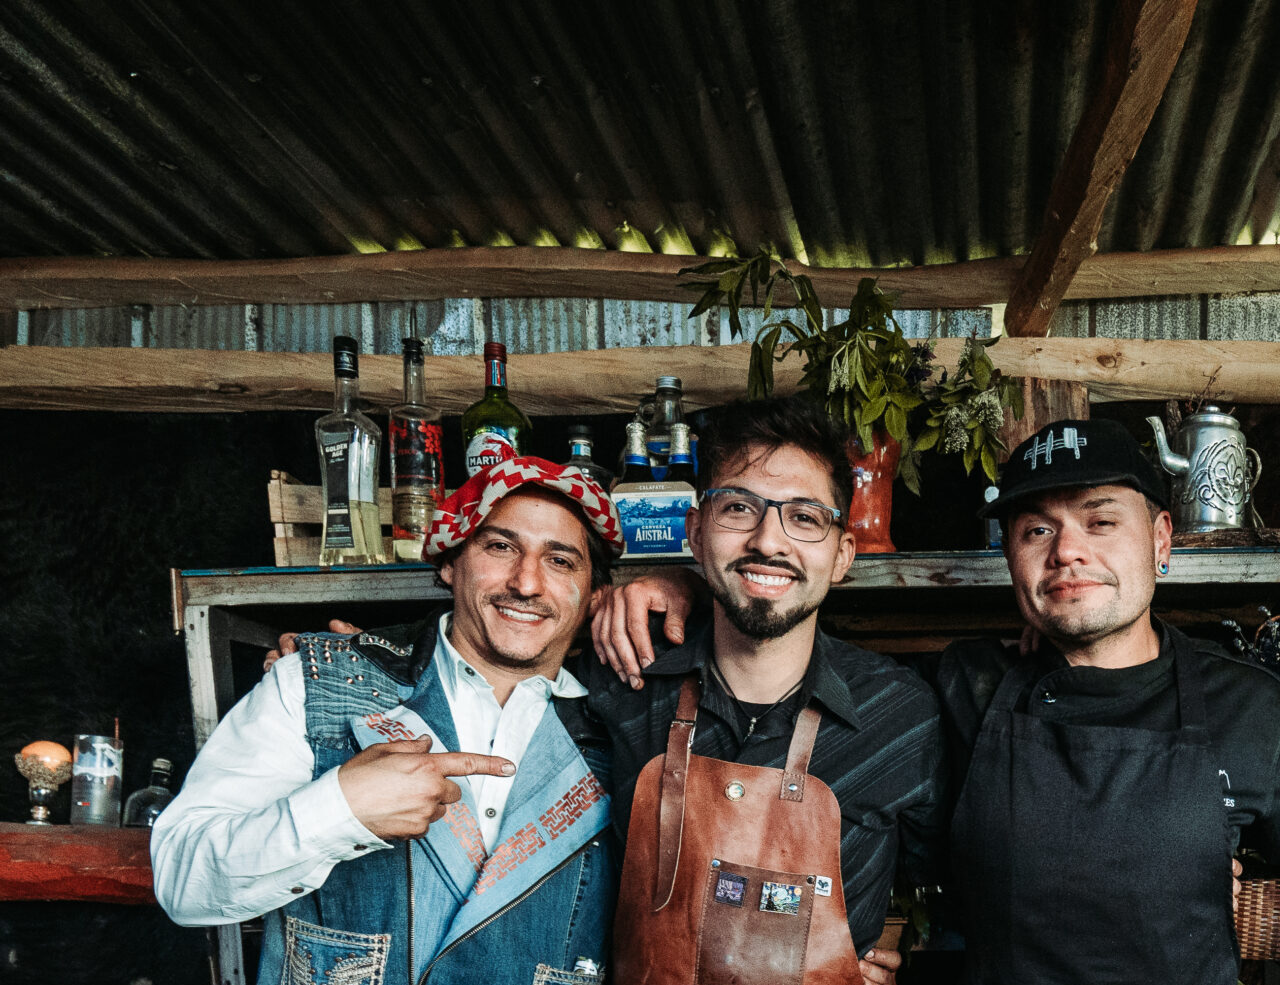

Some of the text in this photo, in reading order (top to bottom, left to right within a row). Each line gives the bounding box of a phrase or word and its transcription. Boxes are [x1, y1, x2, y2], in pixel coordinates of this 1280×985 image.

[325, 443, 348, 452] GOLDEN
[331, 449, 343, 458] AGE
[635, 527, 674, 541] AUSTRAL
